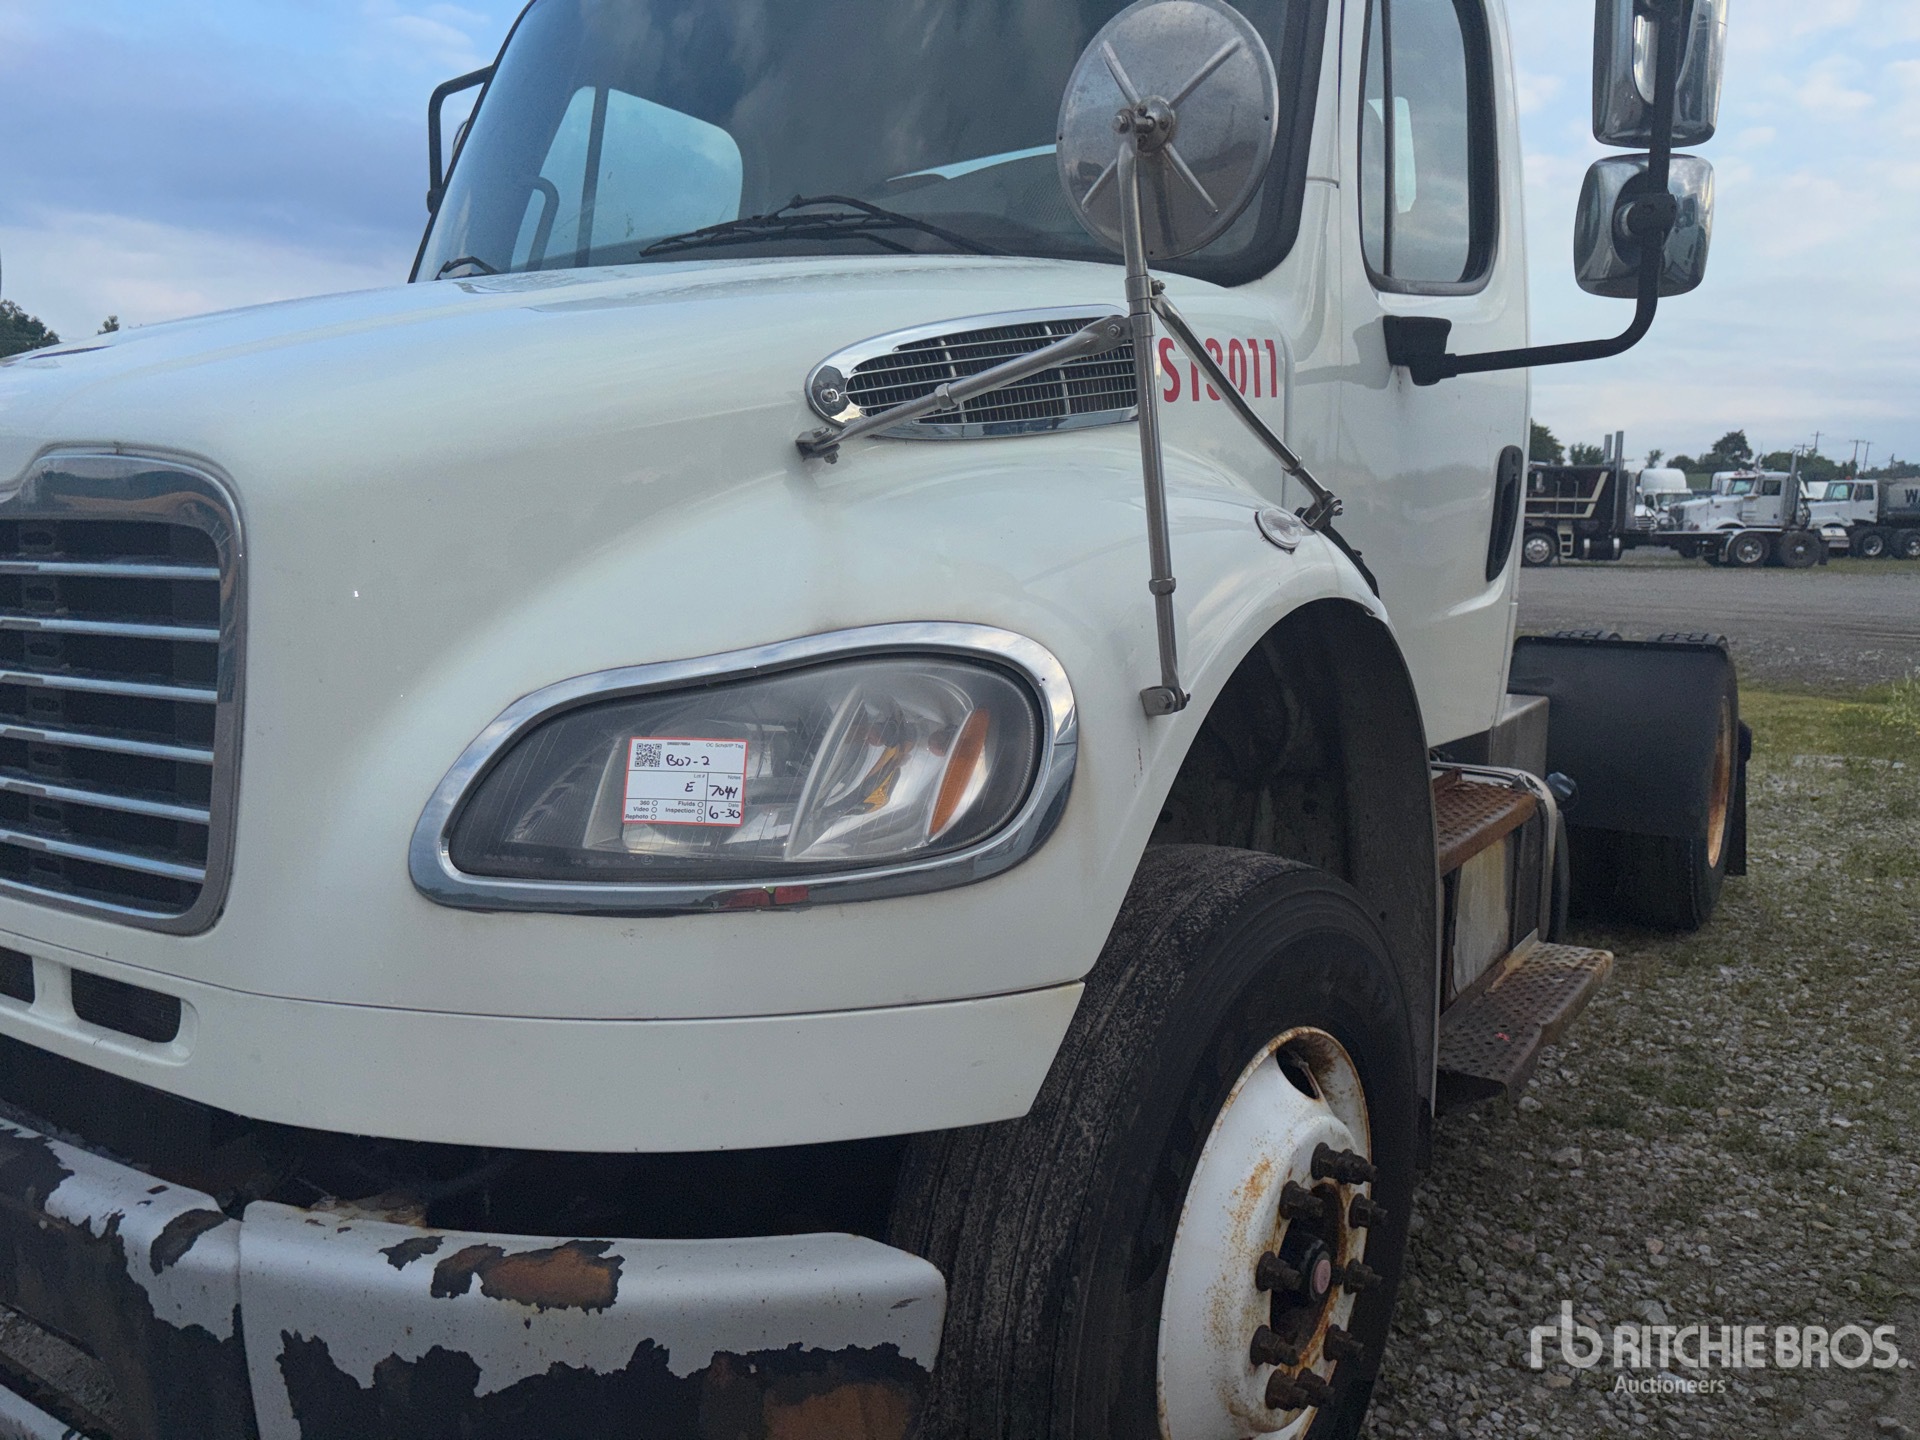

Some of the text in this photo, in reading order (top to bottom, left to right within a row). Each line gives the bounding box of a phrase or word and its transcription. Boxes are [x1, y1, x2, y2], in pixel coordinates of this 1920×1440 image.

[684, 781, 696, 793] E
[665, 807, 696, 815] Inspection
[708, 805, 741, 820] 6-30
